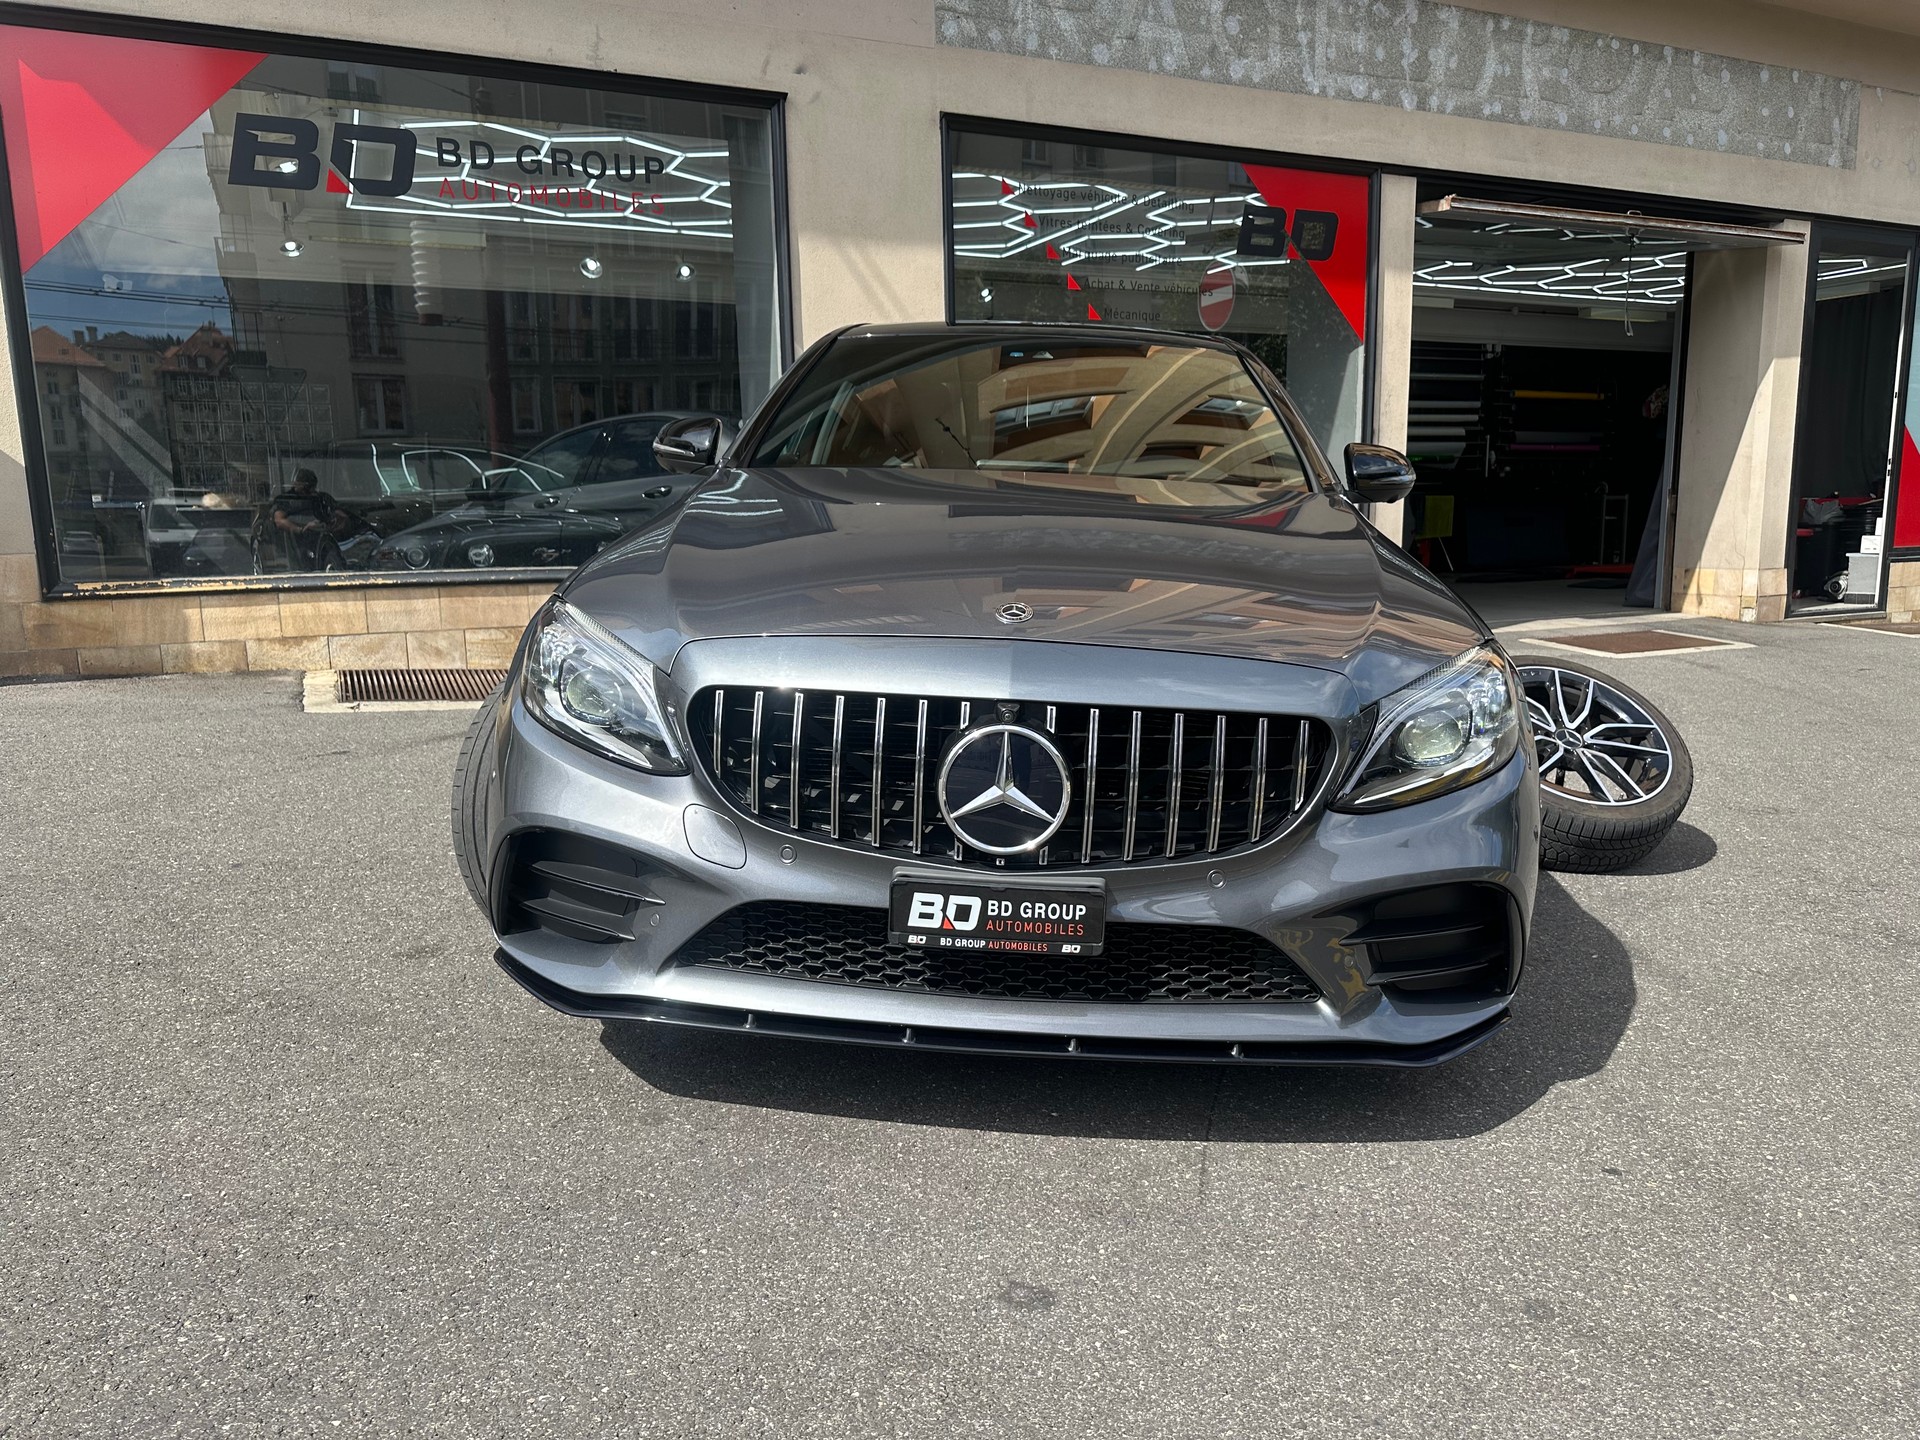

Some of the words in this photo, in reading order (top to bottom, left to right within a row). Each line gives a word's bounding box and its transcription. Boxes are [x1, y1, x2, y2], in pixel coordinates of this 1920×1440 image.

[436, 137, 495, 170] BD
[516, 144, 665, 183] GROUP
[438, 177, 666, 215] AUTOMOBILES
[1018, 182, 1076, 200] Nettoyage
[1081, 188, 1127, 204] véhicule
[1038, 215, 1072, 228] Vitres
[1077, 220, 1121, 233] teintées
[1126, 222, 1133, 234] &
[1137, 223, 1185, 240] Covering
[1084, 277, 1114, 290] Achat
[1118, 280, 1126, 290] &
[1130, 281, 1160, 292] Vente
[1164, 283, 1213, 297] véhicules
[1104, 308, 1161, 322] Mécanique
[987, 900, 1013, 917] BD
[1019, 901, 1087, 920] GROUP
[986, 919, 1084, 936] AUTOMOBILES
[940, 937, 953, 946] BD
[955, 938, 986, 948] GROUP
[988, 942, 1048, 952] AUTOMOBILES
